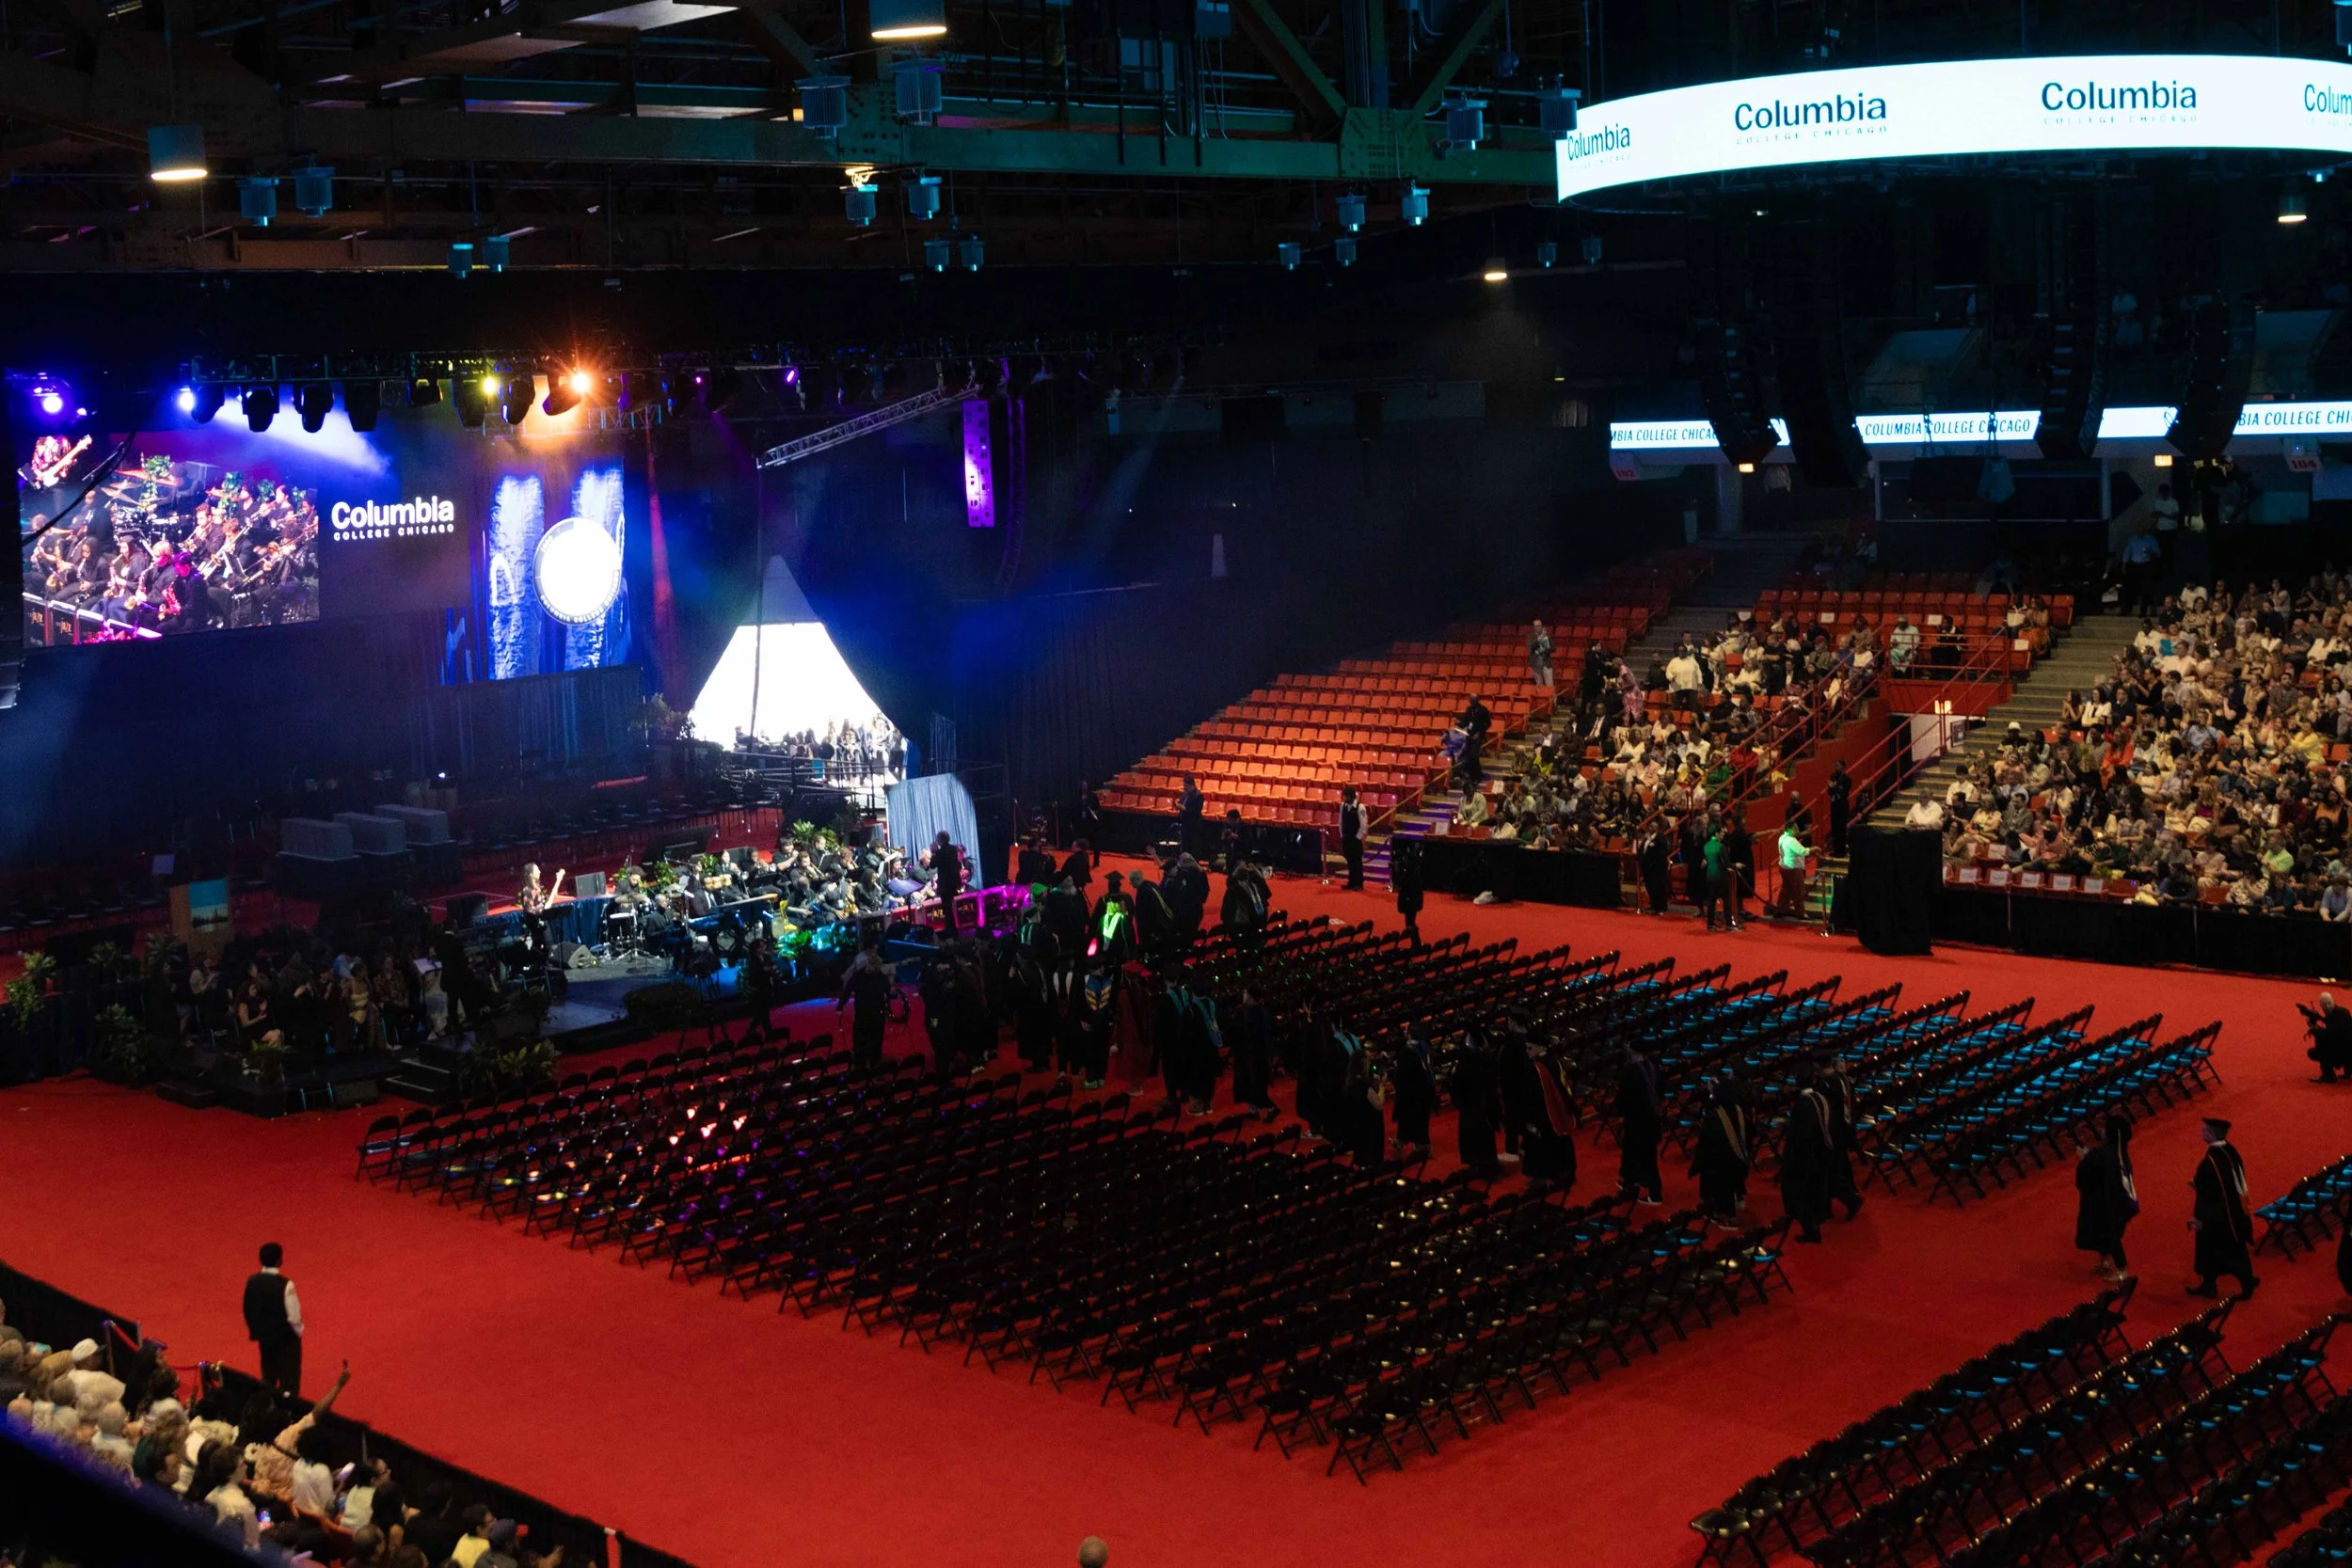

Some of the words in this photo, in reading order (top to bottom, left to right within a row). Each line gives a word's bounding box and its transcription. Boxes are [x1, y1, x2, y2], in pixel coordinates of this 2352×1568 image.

[2042, 80, 2197, 111] Columbia
[2304, 84, 2352, 116] Colum
[1735, 92, 1886, 131] Columbia
[2043, 117, 2116, 125] COLLEGE
[2129, 114, 2198, 123] CHICAGO
[1567, 122, 1630, 162] Columbia
[1737, 132, 1800, 145] COLLEGE
[1813, 125, 1888, 138] CHICAGO
[1866, 421, 1922, 436] COLUMBIA
[1979, 419, 2030, 434] CICAGO
[2265, 411, 2322, 425] COLLEGE
[2327, 410, 2352, 424] CHI
[1636, 429, 1677, 441] COLLEGE
[331, 495, 454, 530] Columbia
[333, 528, 390, 542] COLLEGE
[397, 523, 454, 537] CHICAGO
